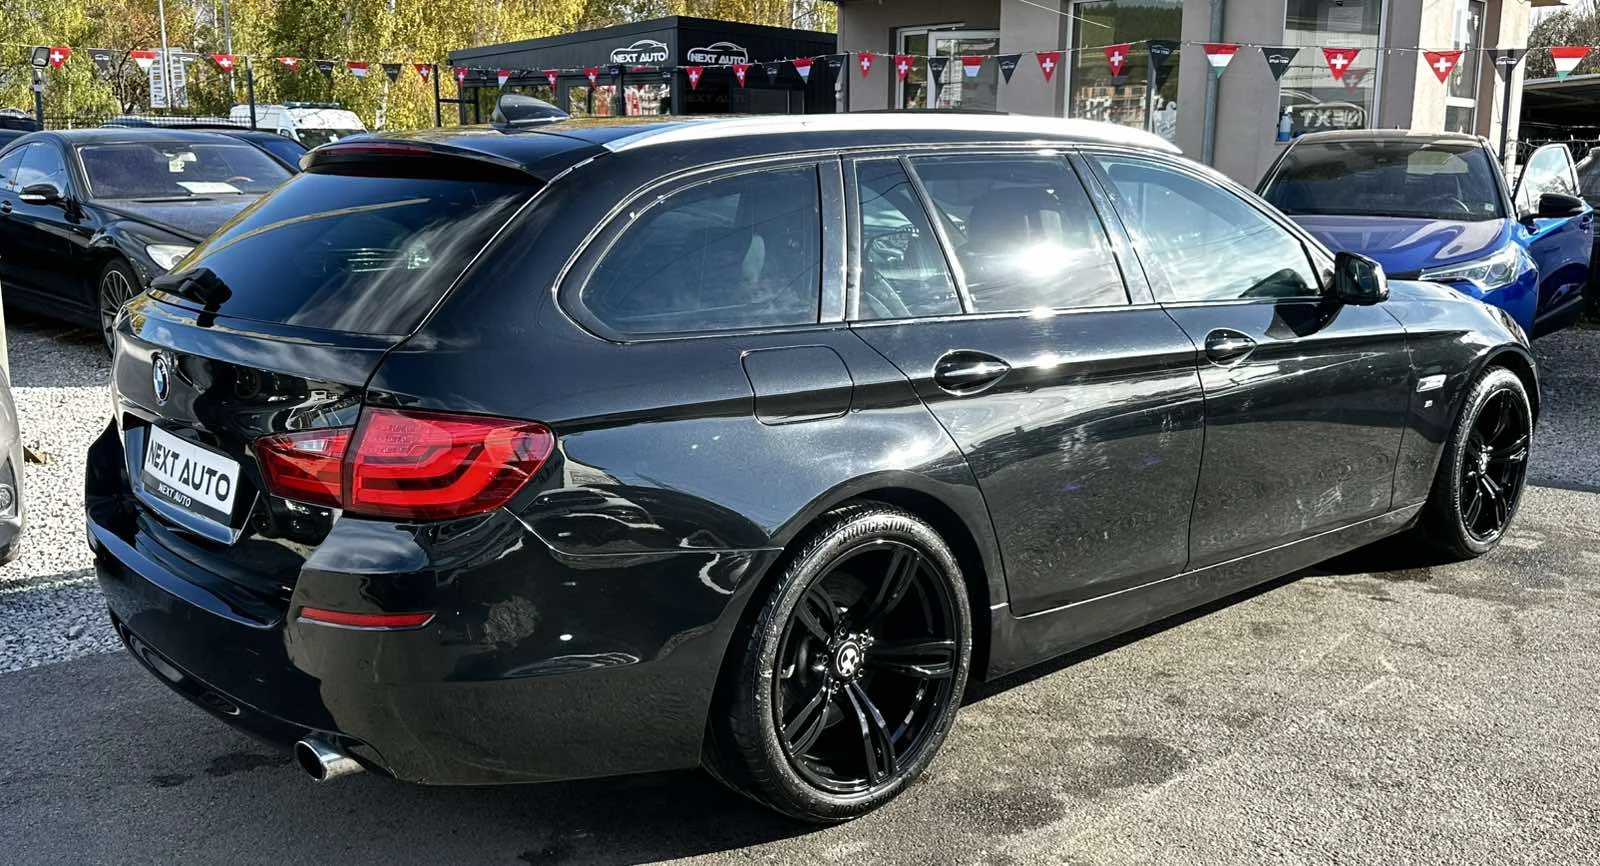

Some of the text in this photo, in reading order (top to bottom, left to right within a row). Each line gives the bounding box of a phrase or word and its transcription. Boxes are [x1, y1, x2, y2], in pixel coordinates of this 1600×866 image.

[613, 52, 666, 62] NEXT AUTO
[690, 54, 746, 64] NEXT AUTO
[148, 440, 231, 502] NEXT AUTO
[158, 482, 191, 507] NEXT AUTO
